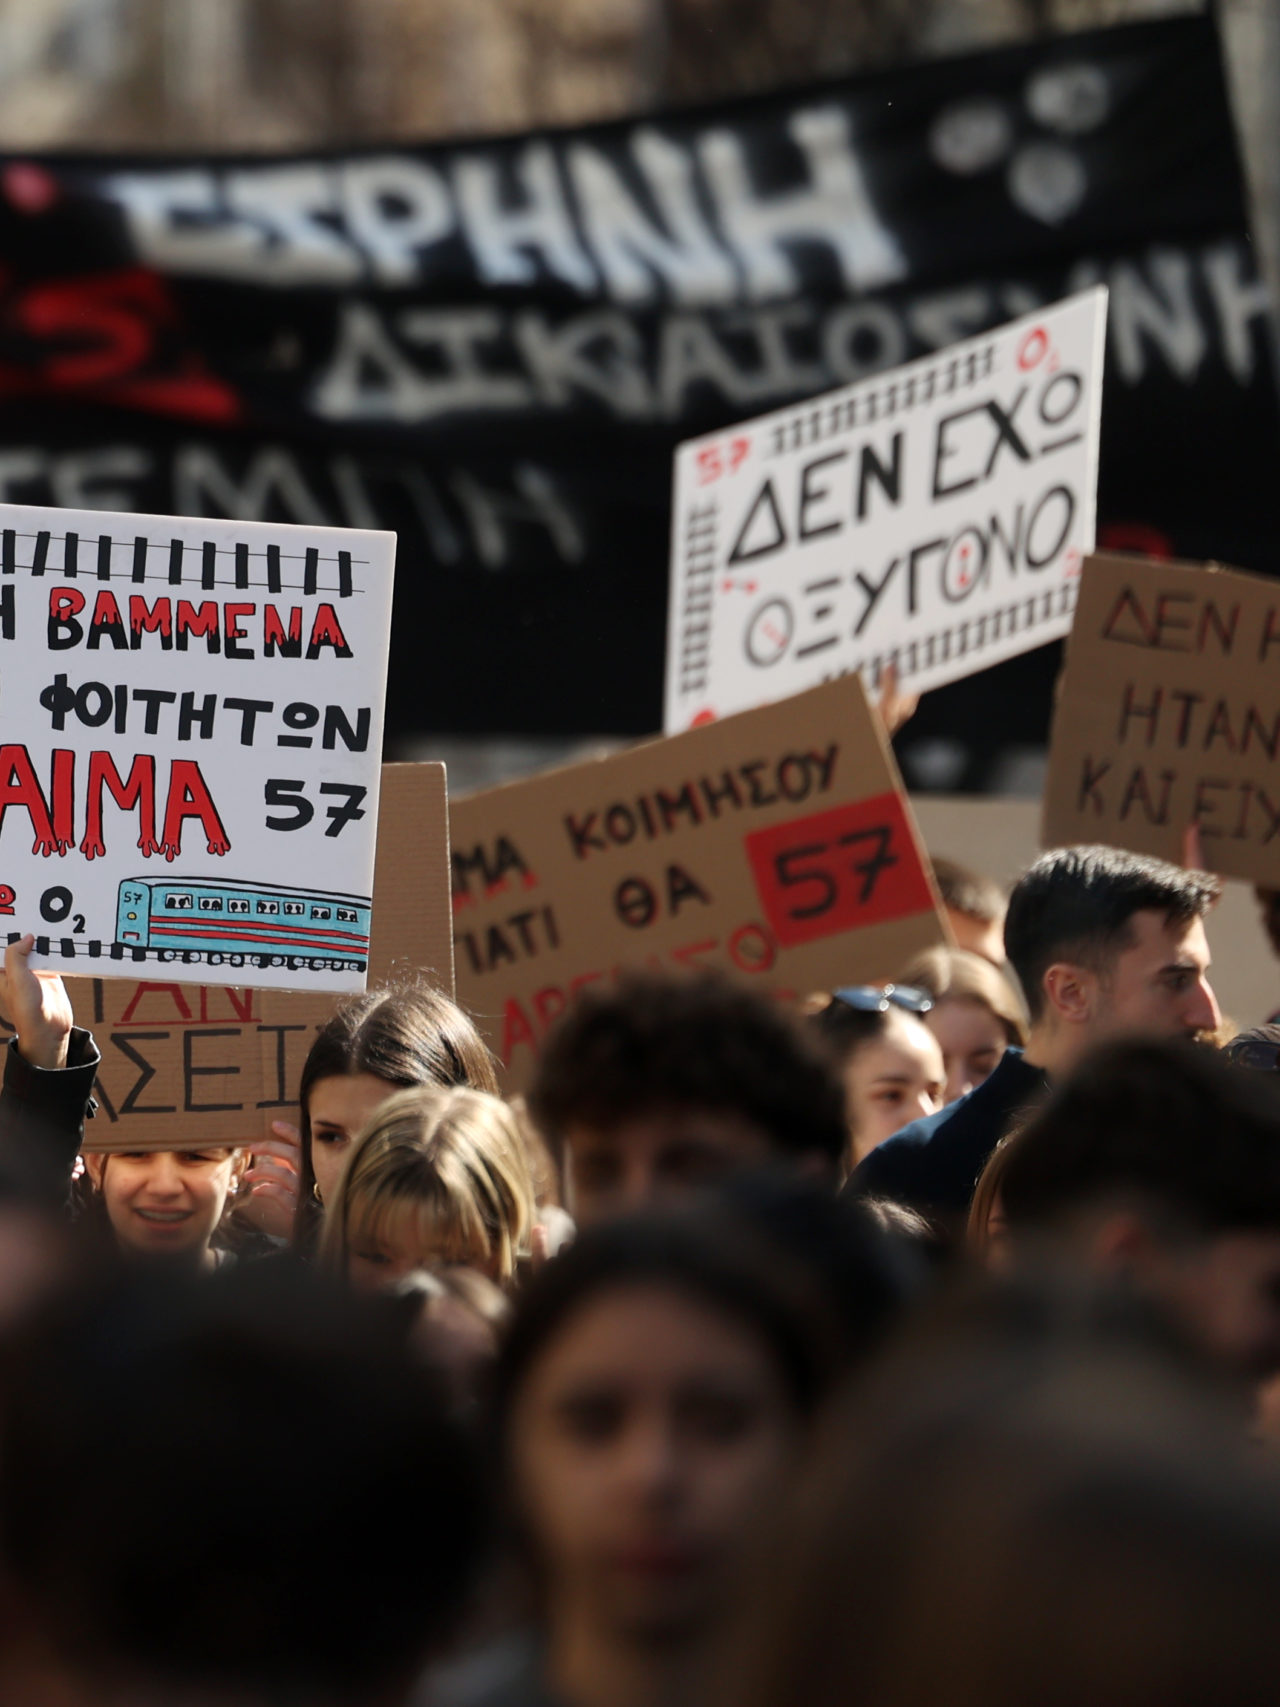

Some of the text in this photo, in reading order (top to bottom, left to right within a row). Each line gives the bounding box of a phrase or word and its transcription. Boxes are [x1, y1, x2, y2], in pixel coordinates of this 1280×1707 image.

[110, 104, 906, 302] ΕΙΡΗΝΗ
[726, 370, 1084, 569] ΔΕΝ ΕΧΩ
[742, 484, 1077, 670] ΟΞΥΓΟΝΟ
[1100, 583, 1242, 657] ΔΕΝ
[48, 587, 354, 659] ΒΑΜΜΕΝΑ
[39, 673, 371, 752] ΦΟΙΤΗΤΩΝ
[1117, 680, 1280, 762] ΗΤΑΝ
[265, 778, 367, 837] 57
[563, 742, 840, 860] ΚΟΙΜΗΣΟΥ
[124, 891, 142, 905] 57
[773, 824, 899, 921] 57
[455, 862, 712, 977] ΙΑΤΙ ΘΑ
